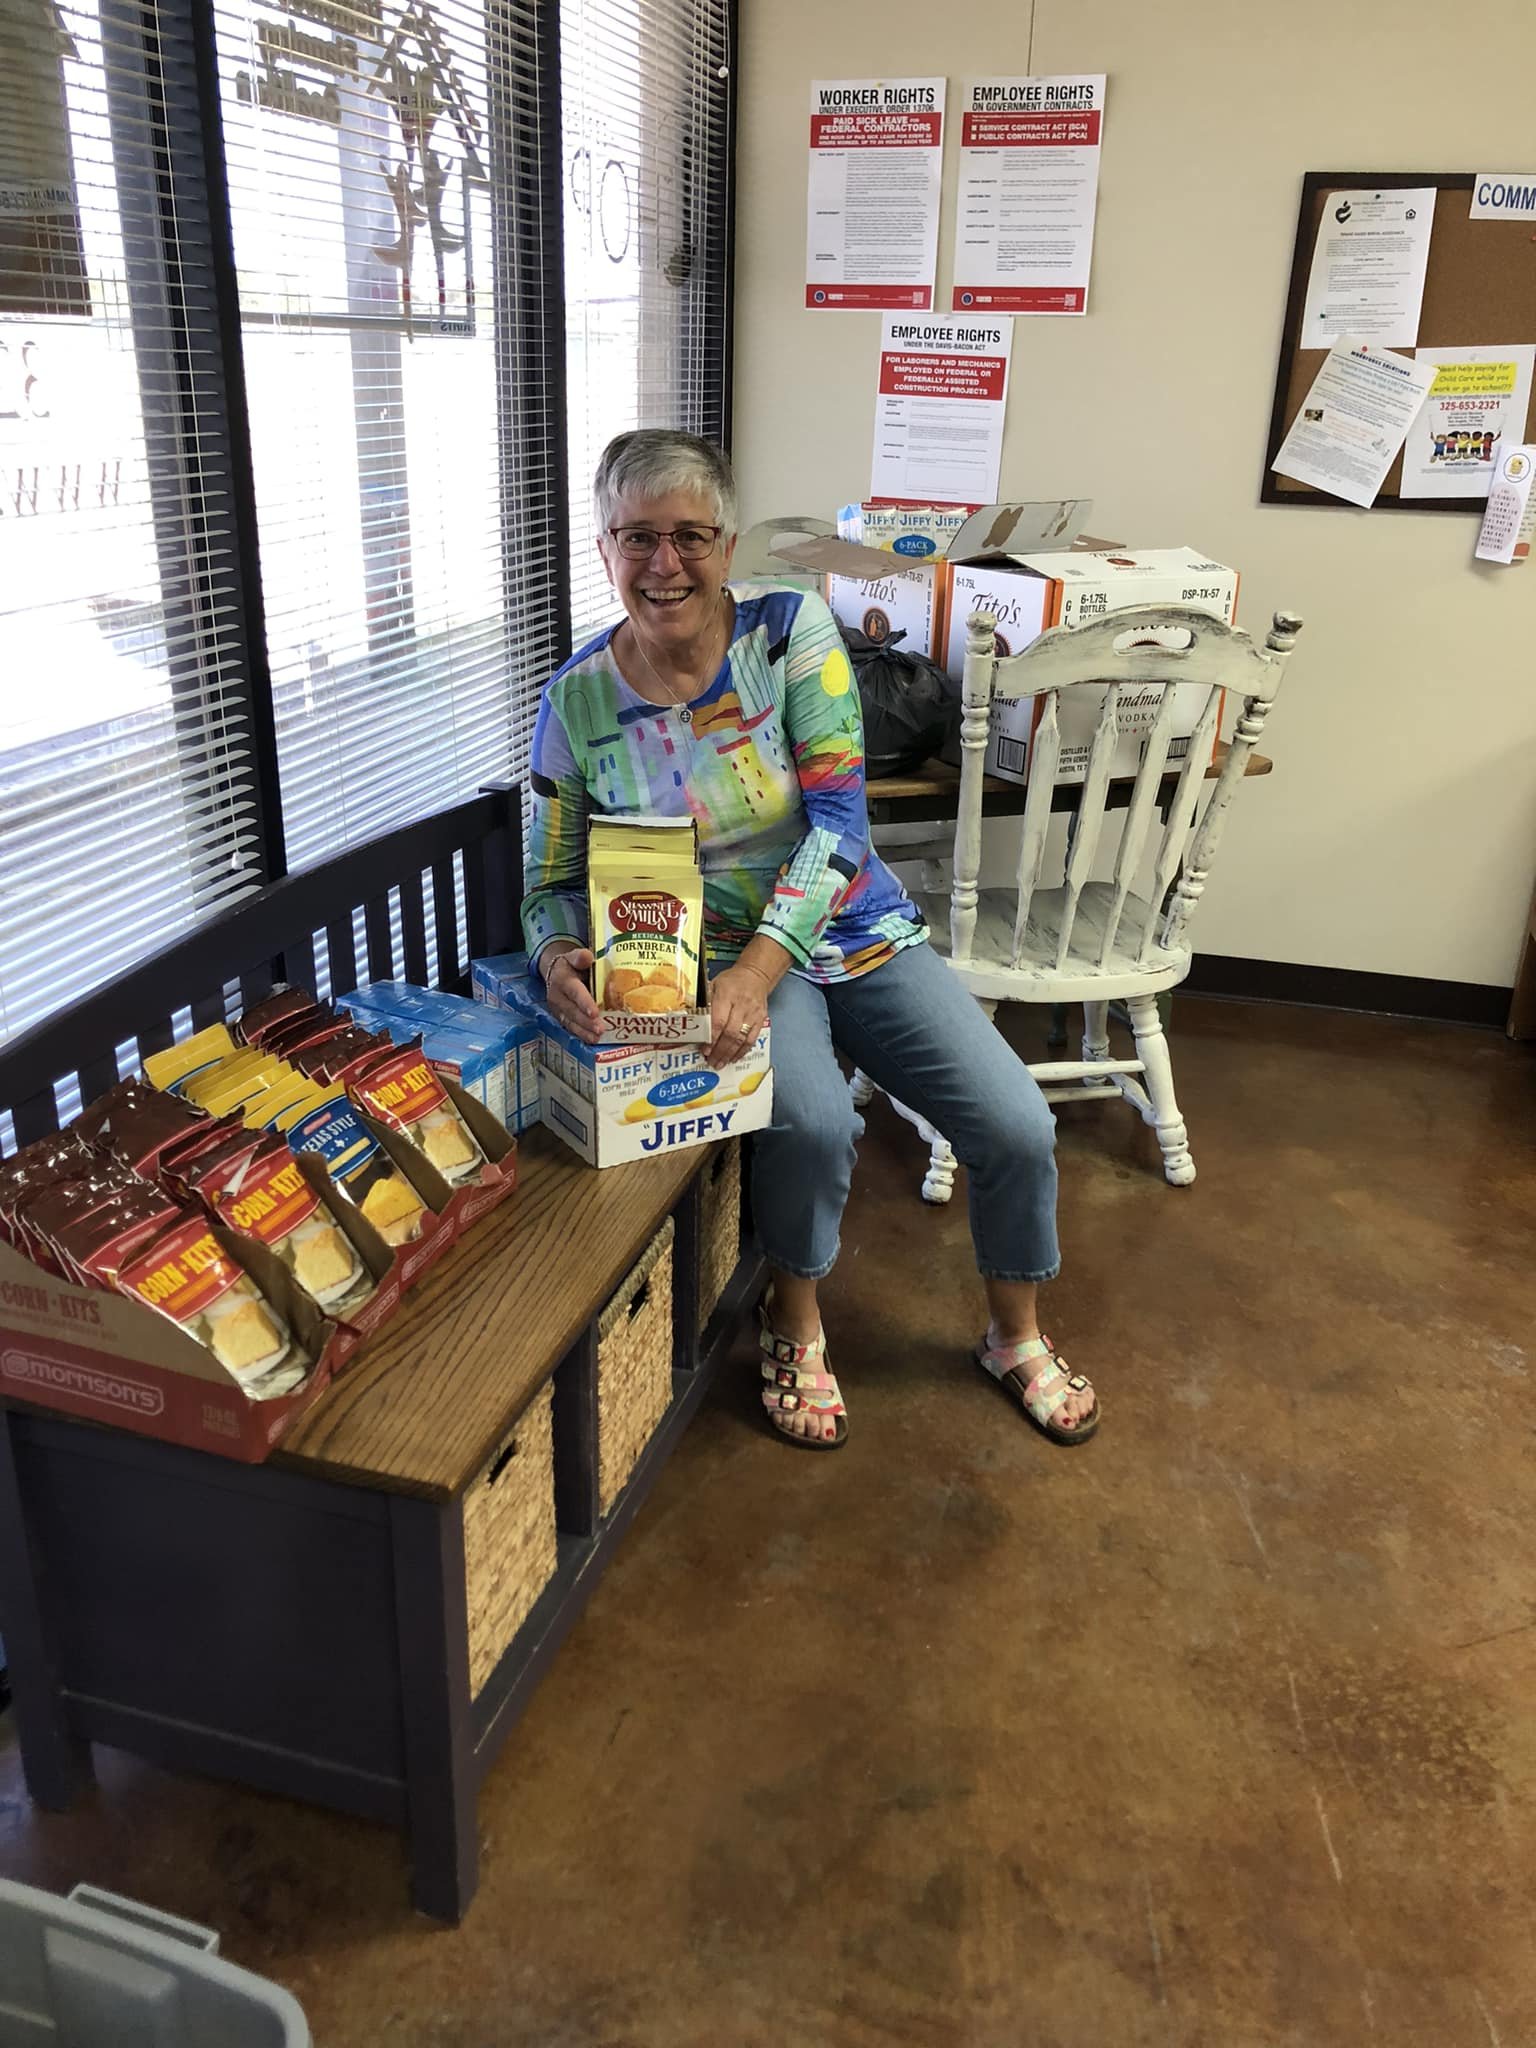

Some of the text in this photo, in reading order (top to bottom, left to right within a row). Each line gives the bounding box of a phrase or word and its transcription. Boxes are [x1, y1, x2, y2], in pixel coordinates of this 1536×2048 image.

[820, 88, 935, 105] WORKER RIGHTS
[973, 85, 1094, 101] EMPLOYEE RIGHTS
[819, 106, 843, 114] UNDER
[845, 105, 883, 113] EXECUTIVE
[913, 104, 934, 112] 13706
[972, 101, 1093, 111] ON GOVERNMENT CONTRACTS
[833, 117, 854, 125] PAID
[880, 116, 908, 124] LEAVE
[821, 124, 931, 133] FEDERAL CONTRACTORS
[1478, 182, 1536, 210] COMM
[891, 325, 1001, 343] EMPLOYEE RIGHTS
[935, 342, 973, 350] DAVIS-BACON
[902, 358, 939, 366] LABORERS
[958, 360, 1001, 368] MECHANICS
[893, 366, 932, 374] EMPLOYED
[946, 368, 978, 377] FEDERAL
[903, 375, 979, 385] FEDERALLY ASSISTED
[893, 384, 988, 395] CONSTRUCTION PROJECTS
[1440, 401, 1500, 411] 325-653-2321
[900, 540, 928, 550] 6-PACK
[1080, 593, 1109, 604] 6-1.75L
[1182, 588, 1220, 600] DSP-TX-57
[971, 592, 1021, 625] Tito's
[1080, 604, 1106, 614] BOTTLES
[1117, 713, 1156, 723] VODKA
[616, 898, 680, 919] SHAWNEE
[626, 909, 668, 932] MILLS
[632, 933, 664, 941] MEXICAN
[637, 951, 657, 960] MIX
[603, 1013, 700, 1032] SHAWNEE
[660, 1051, 700, 1071] JIFF
[658, 1077, 706, 1098] 6-PACK
[300, 1113, 357, 1152] TEXAS STYLE
[231, 1188, 278, 1229] CORN
[137, 1261, 188, 1304] CORN
[30, 1359, 157, 1409] morrison's
